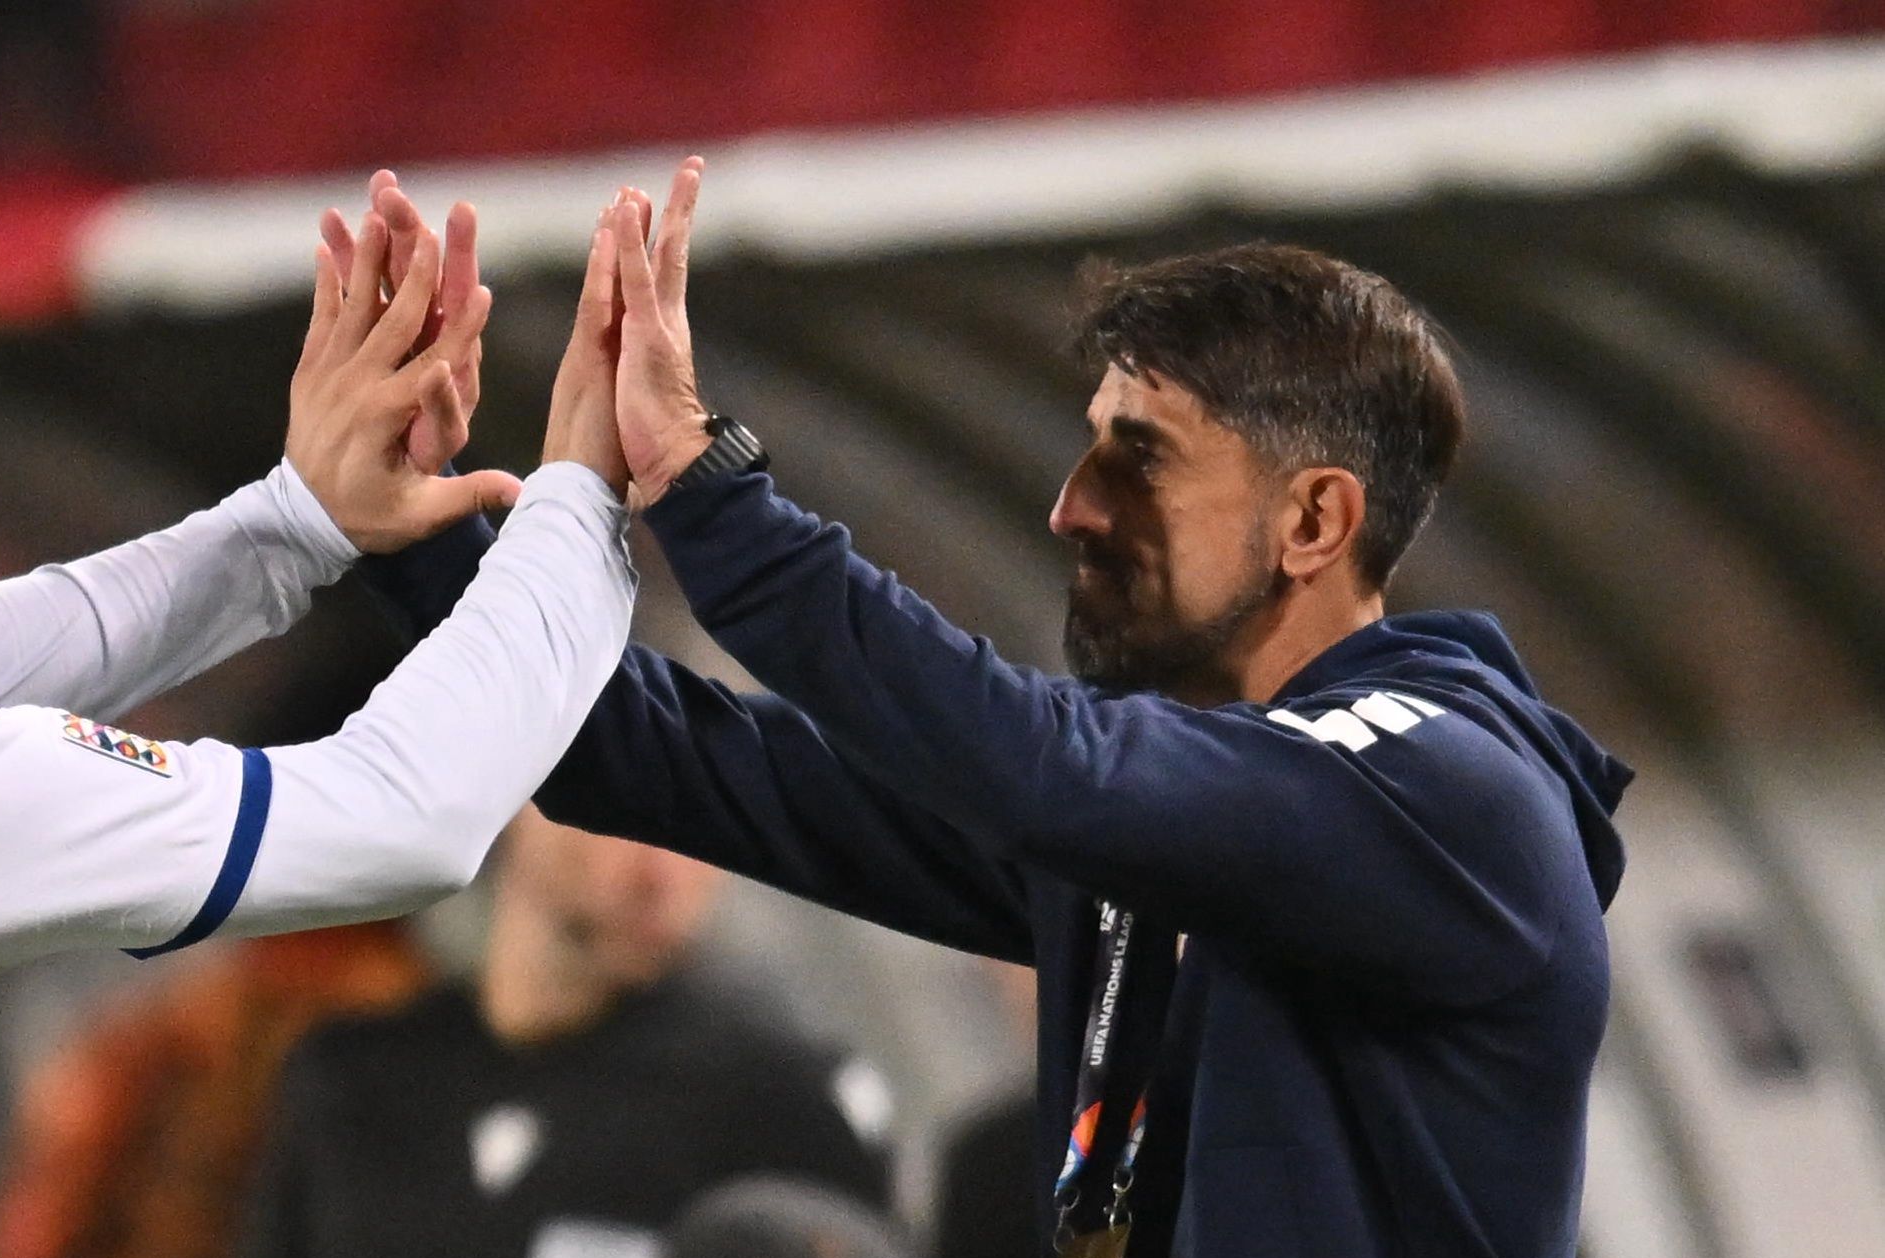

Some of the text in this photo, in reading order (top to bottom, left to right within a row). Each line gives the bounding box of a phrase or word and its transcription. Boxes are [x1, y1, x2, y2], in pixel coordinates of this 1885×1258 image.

[1089, 912, 1134, 1066] UEFA NATIONS LEAG
